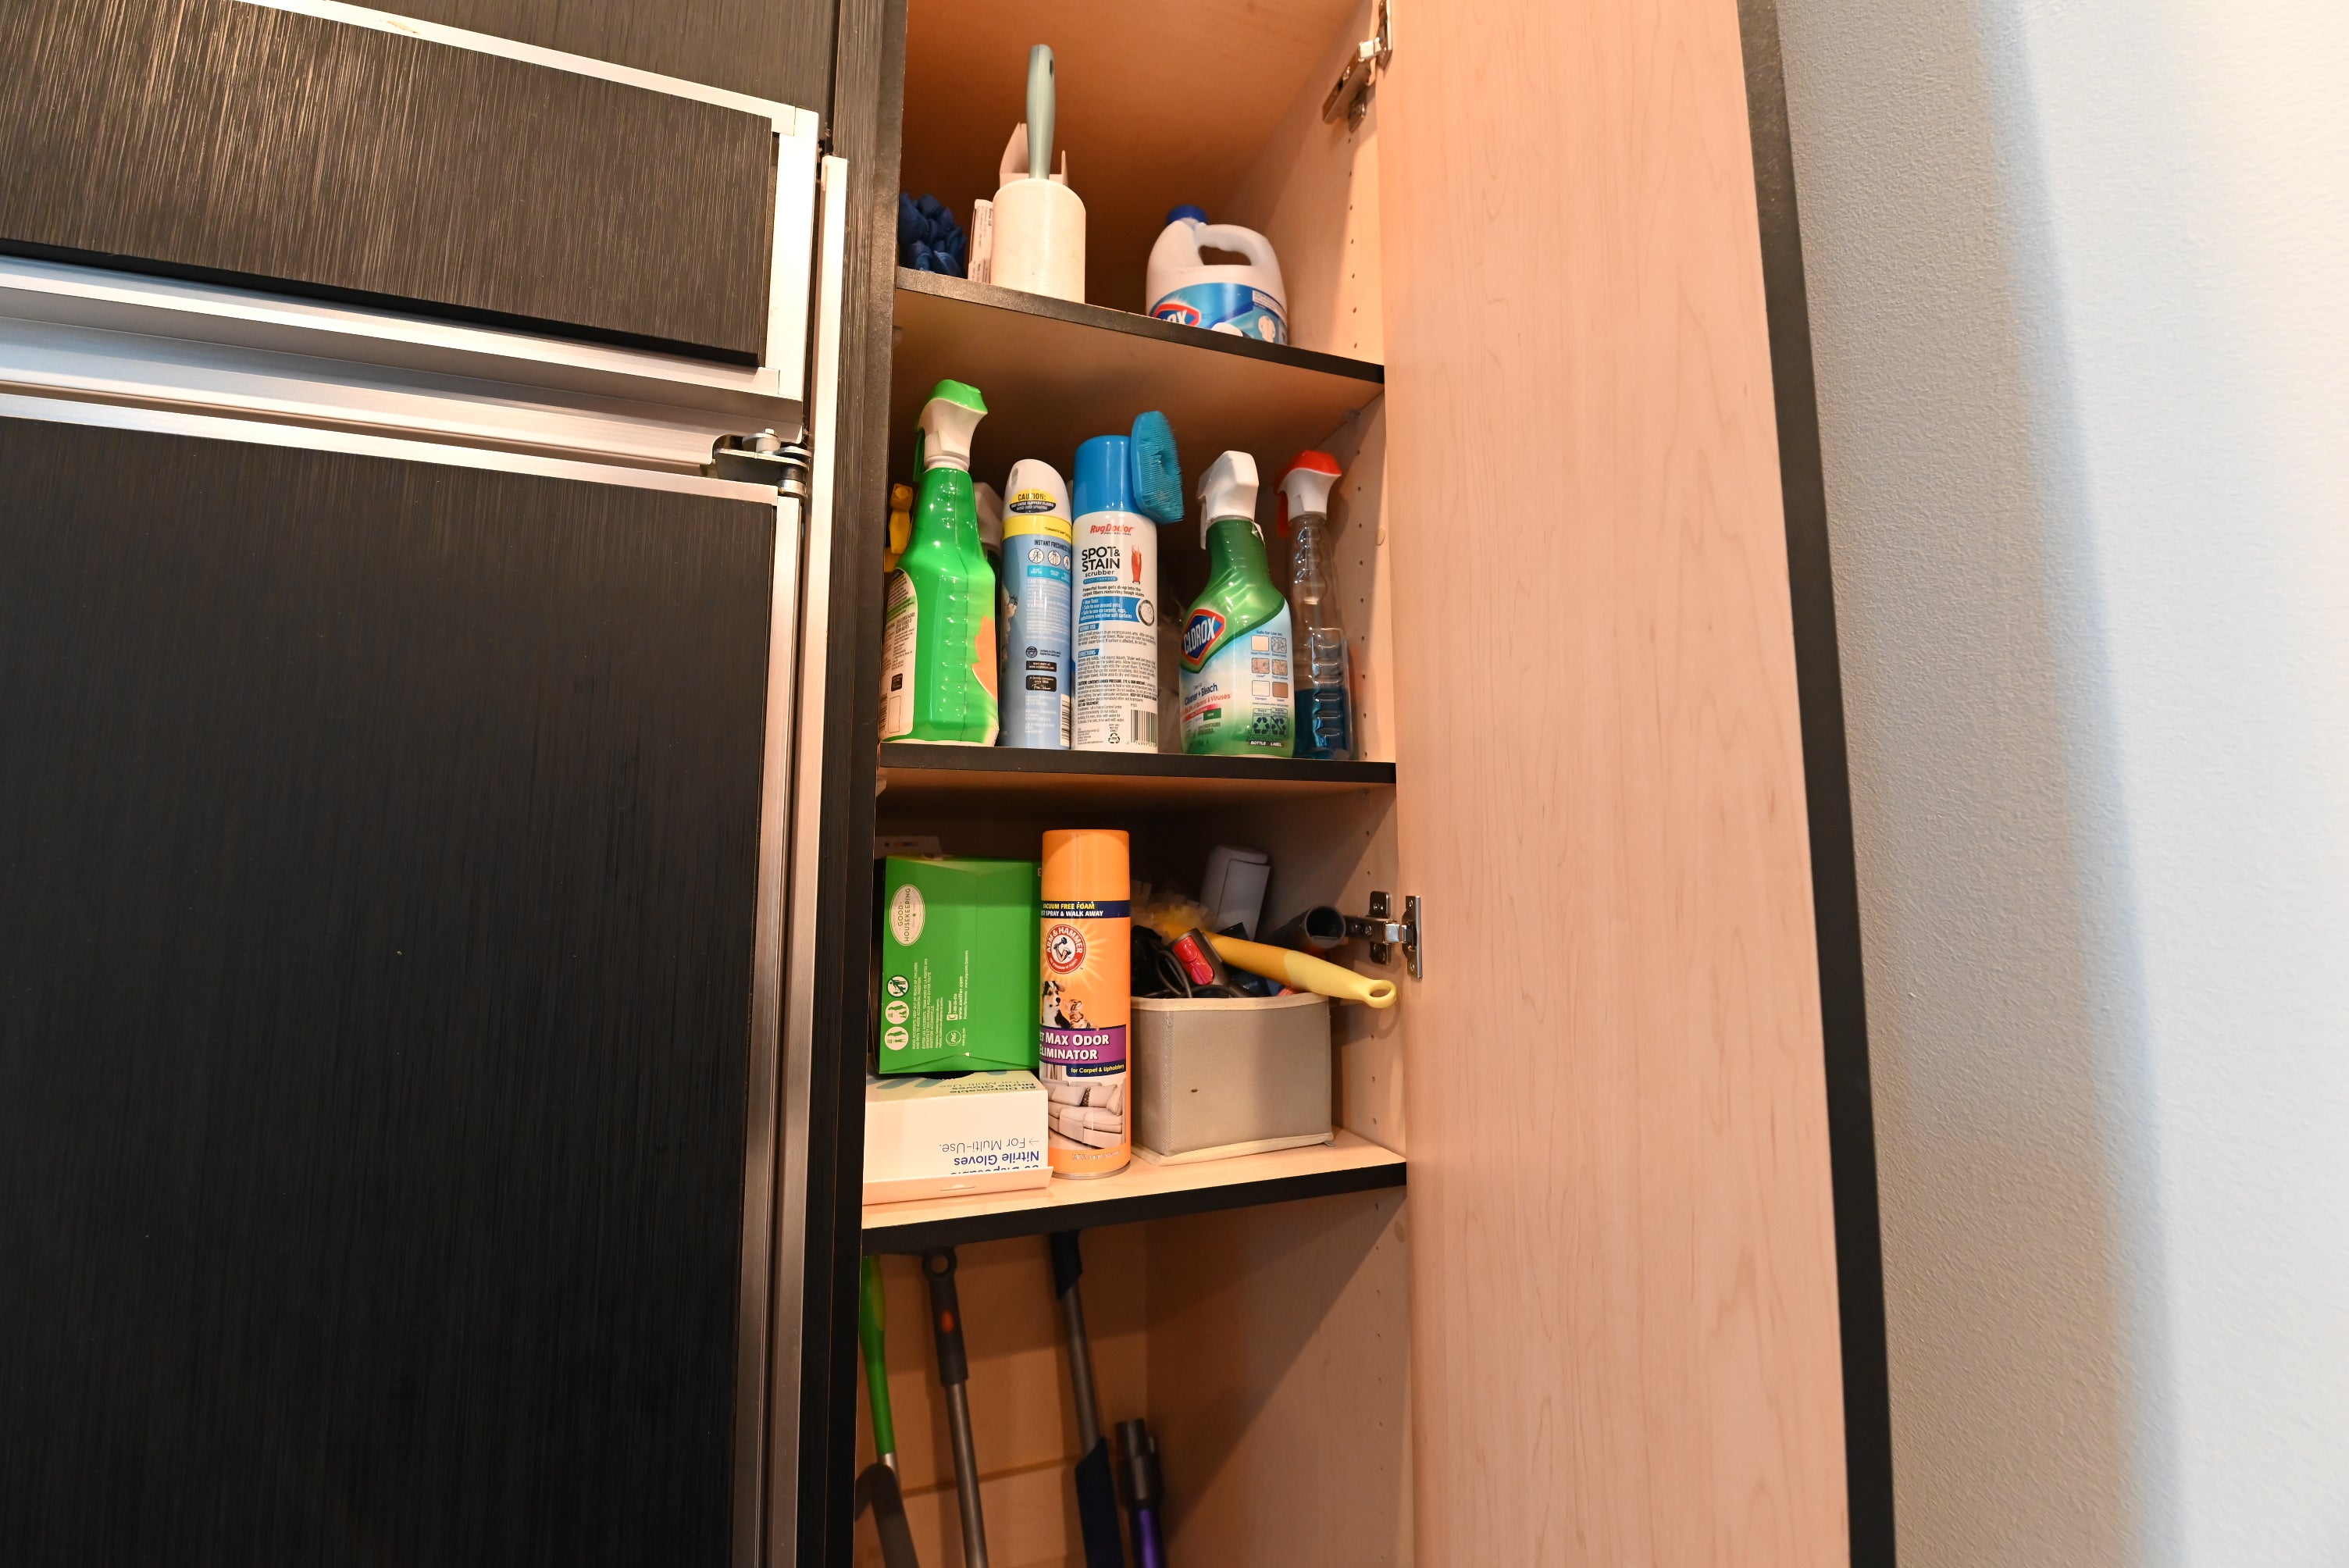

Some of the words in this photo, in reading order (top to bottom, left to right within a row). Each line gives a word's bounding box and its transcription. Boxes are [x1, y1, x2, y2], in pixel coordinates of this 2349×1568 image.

[1082, 547, 1116, 561] SPOT
[1082, 558, 1120, 572] STAIN
[1183, 615, 1216, 654] CLOROX
[1185, 693, 1198, 706] Cleaner
[1201, 682, 1217, 697] Bleach
[1210, 693, 1231, 702] Viruses
[1058, 926, 1083, 953] HAMMER
[939, 1139, 1002, 1153] Multi-Use.
[1006, 1138, 1025, 1149] For
[954, 1153, 998, 1166] Gloves
[1001, 1151, 1039, 1164] Nitrile
